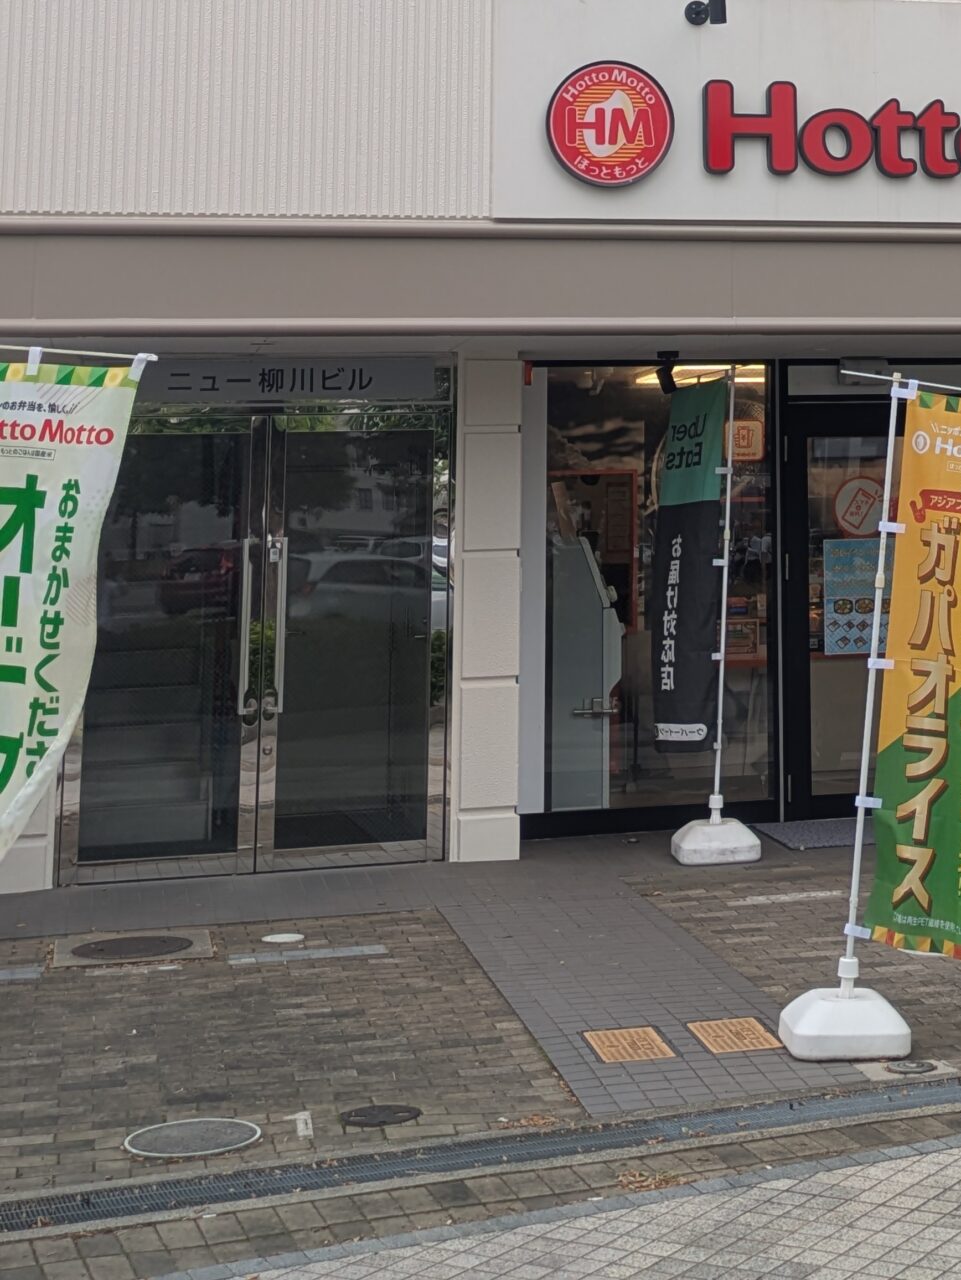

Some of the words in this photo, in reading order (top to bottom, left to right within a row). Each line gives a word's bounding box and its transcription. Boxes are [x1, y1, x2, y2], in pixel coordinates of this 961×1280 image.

[565, 106, 655, 147] HM
[574, 155, 649, 179] ほっともっと
[166, 366, 374, 394] ニュー柳川ビル
[0, 400, 69, 415] のお弁当を、愉しく。
[892, 516, 961, 913] ガパオライス
